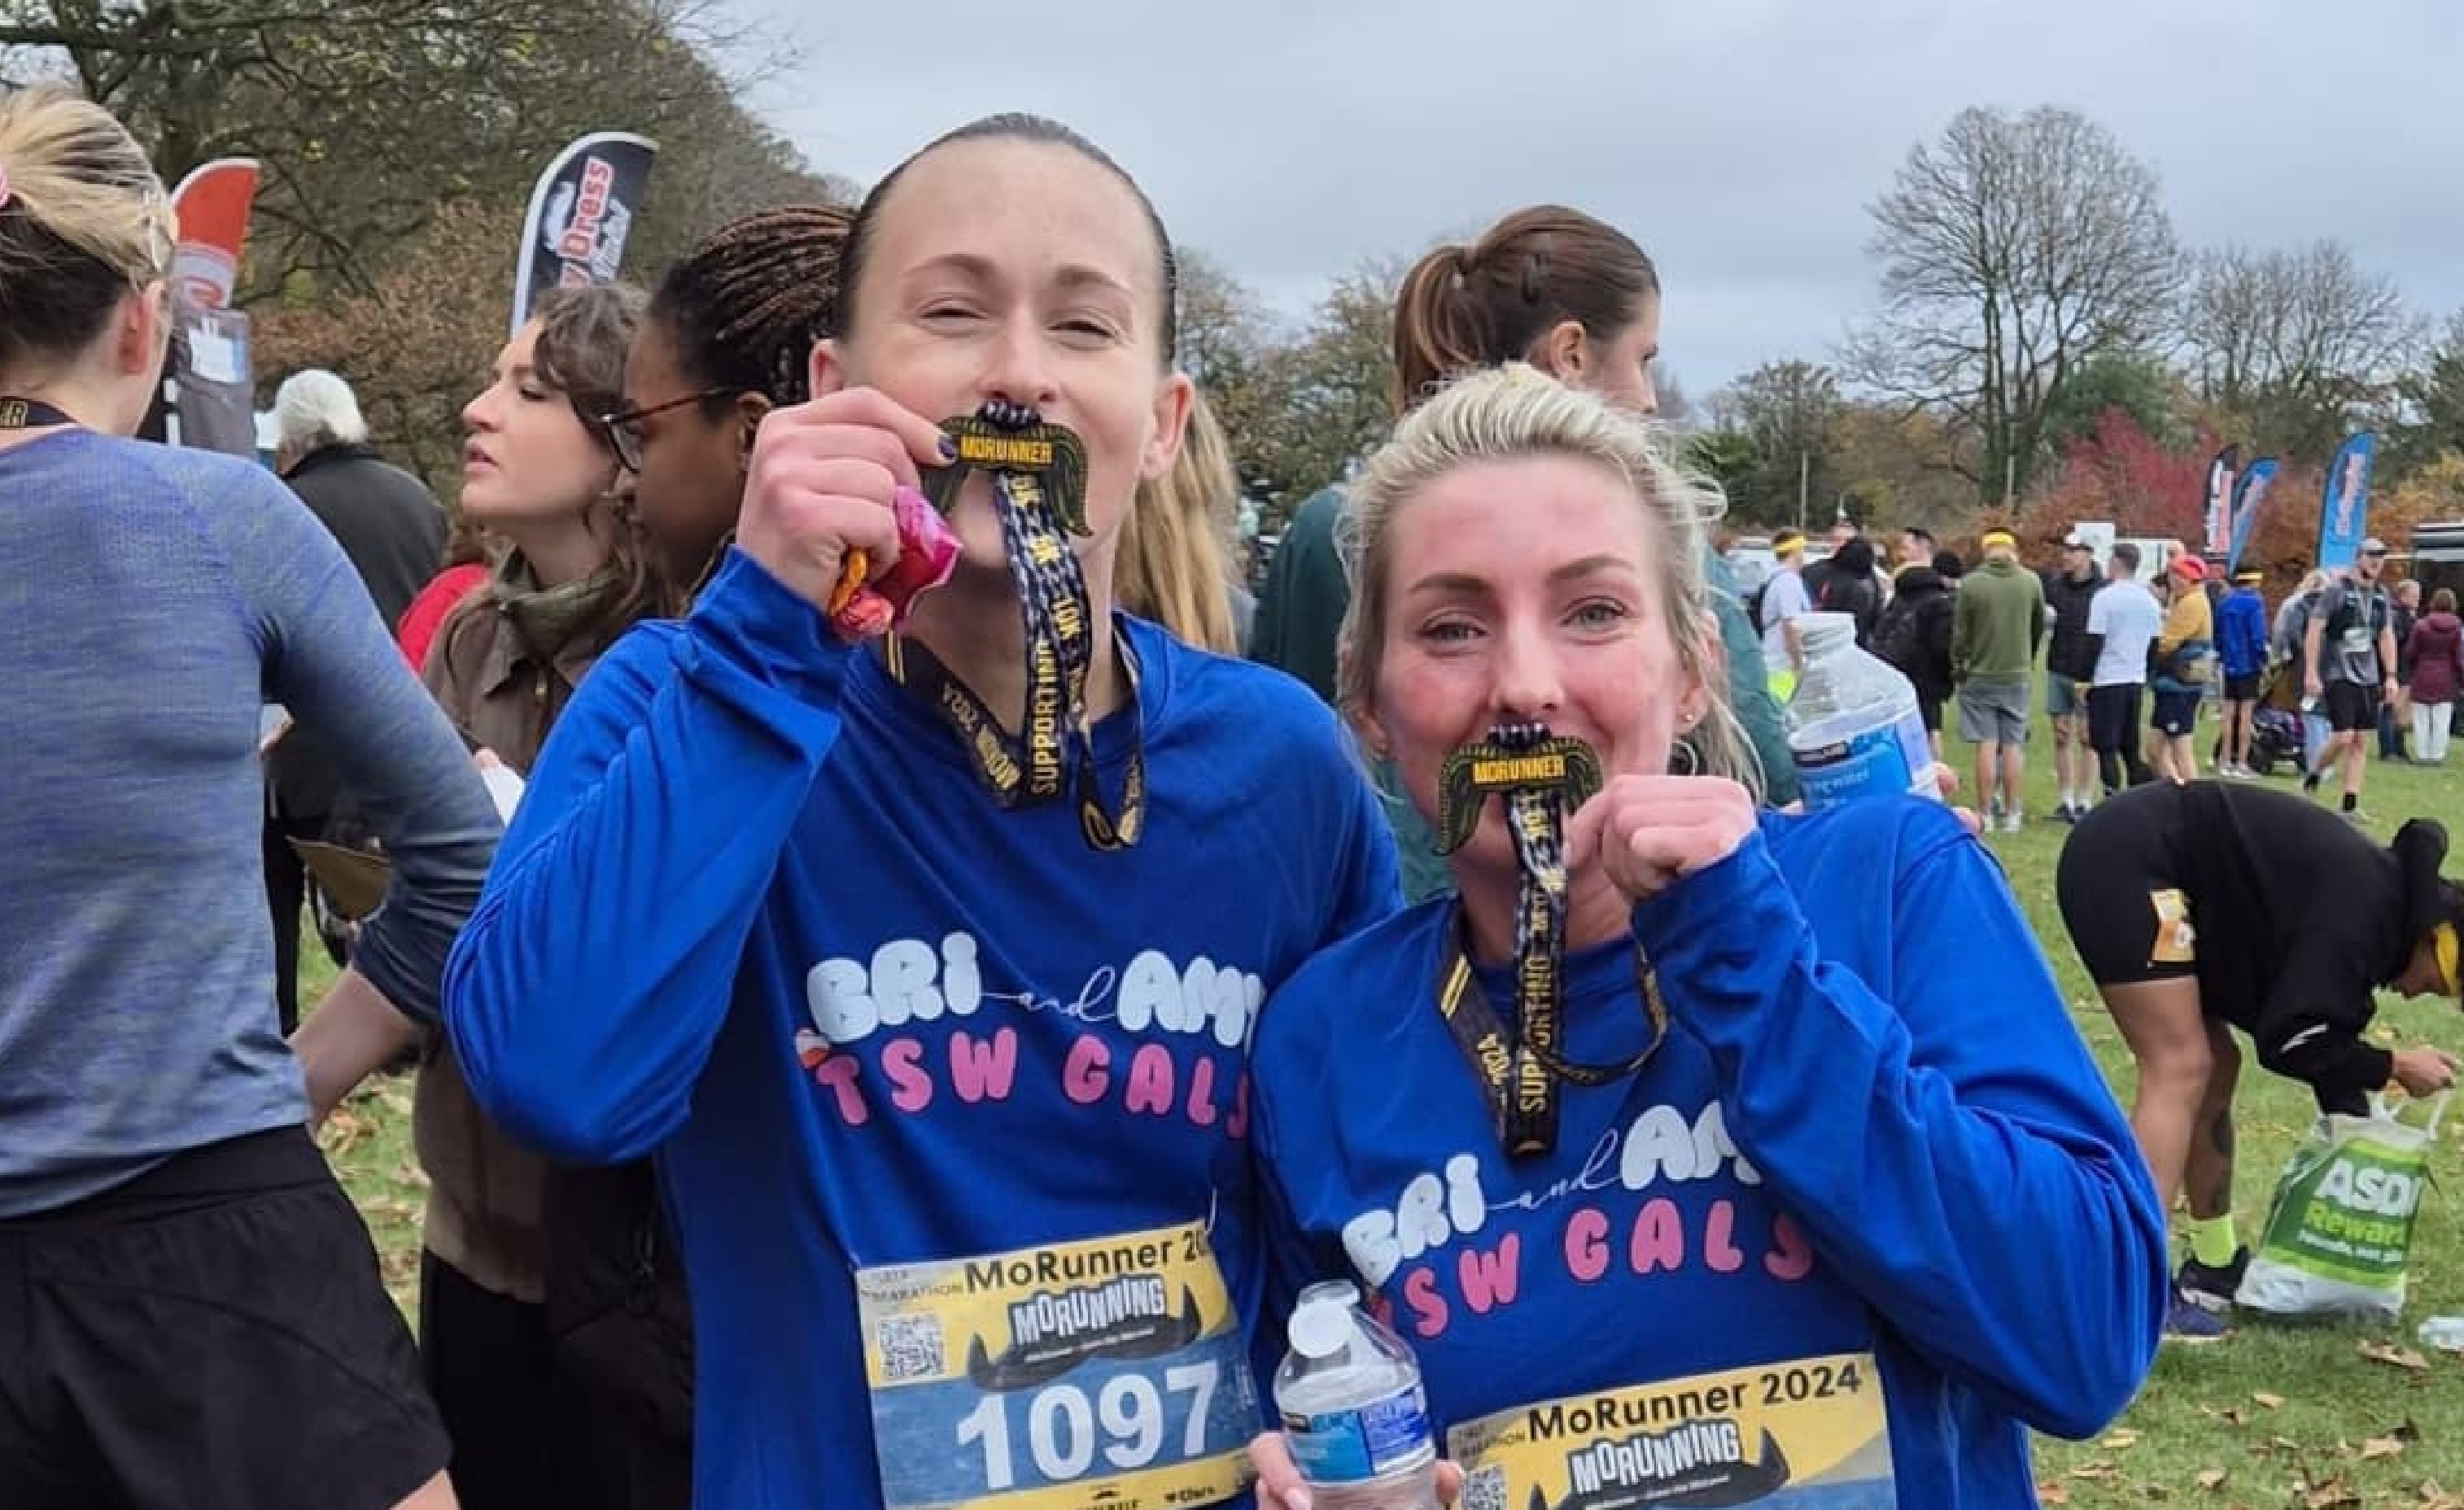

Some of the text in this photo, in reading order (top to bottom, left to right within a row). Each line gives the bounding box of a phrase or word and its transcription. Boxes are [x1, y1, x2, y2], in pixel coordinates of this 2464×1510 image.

[561, 159, 613, 259] Dress
[960, 436, 1052, 465] MORUNNER
[1472, 755, 1566, 783] MORUNNER
[807, 932, 981, 1042] BRI
[816, 1027, 1018, 1125] TSW
[1343, 1100, 1762, 1285] BRI and AM
[2304, 1199, 2405, 1246] Rewar
[2314, 1157, 2422, 1216] ASD
[965, 1229, 1208, 1294] MoRunner 20
[956, 1362, 1217, 1490] 1097
[1529, 1362, 1863, 1442] MoRunner 2024
